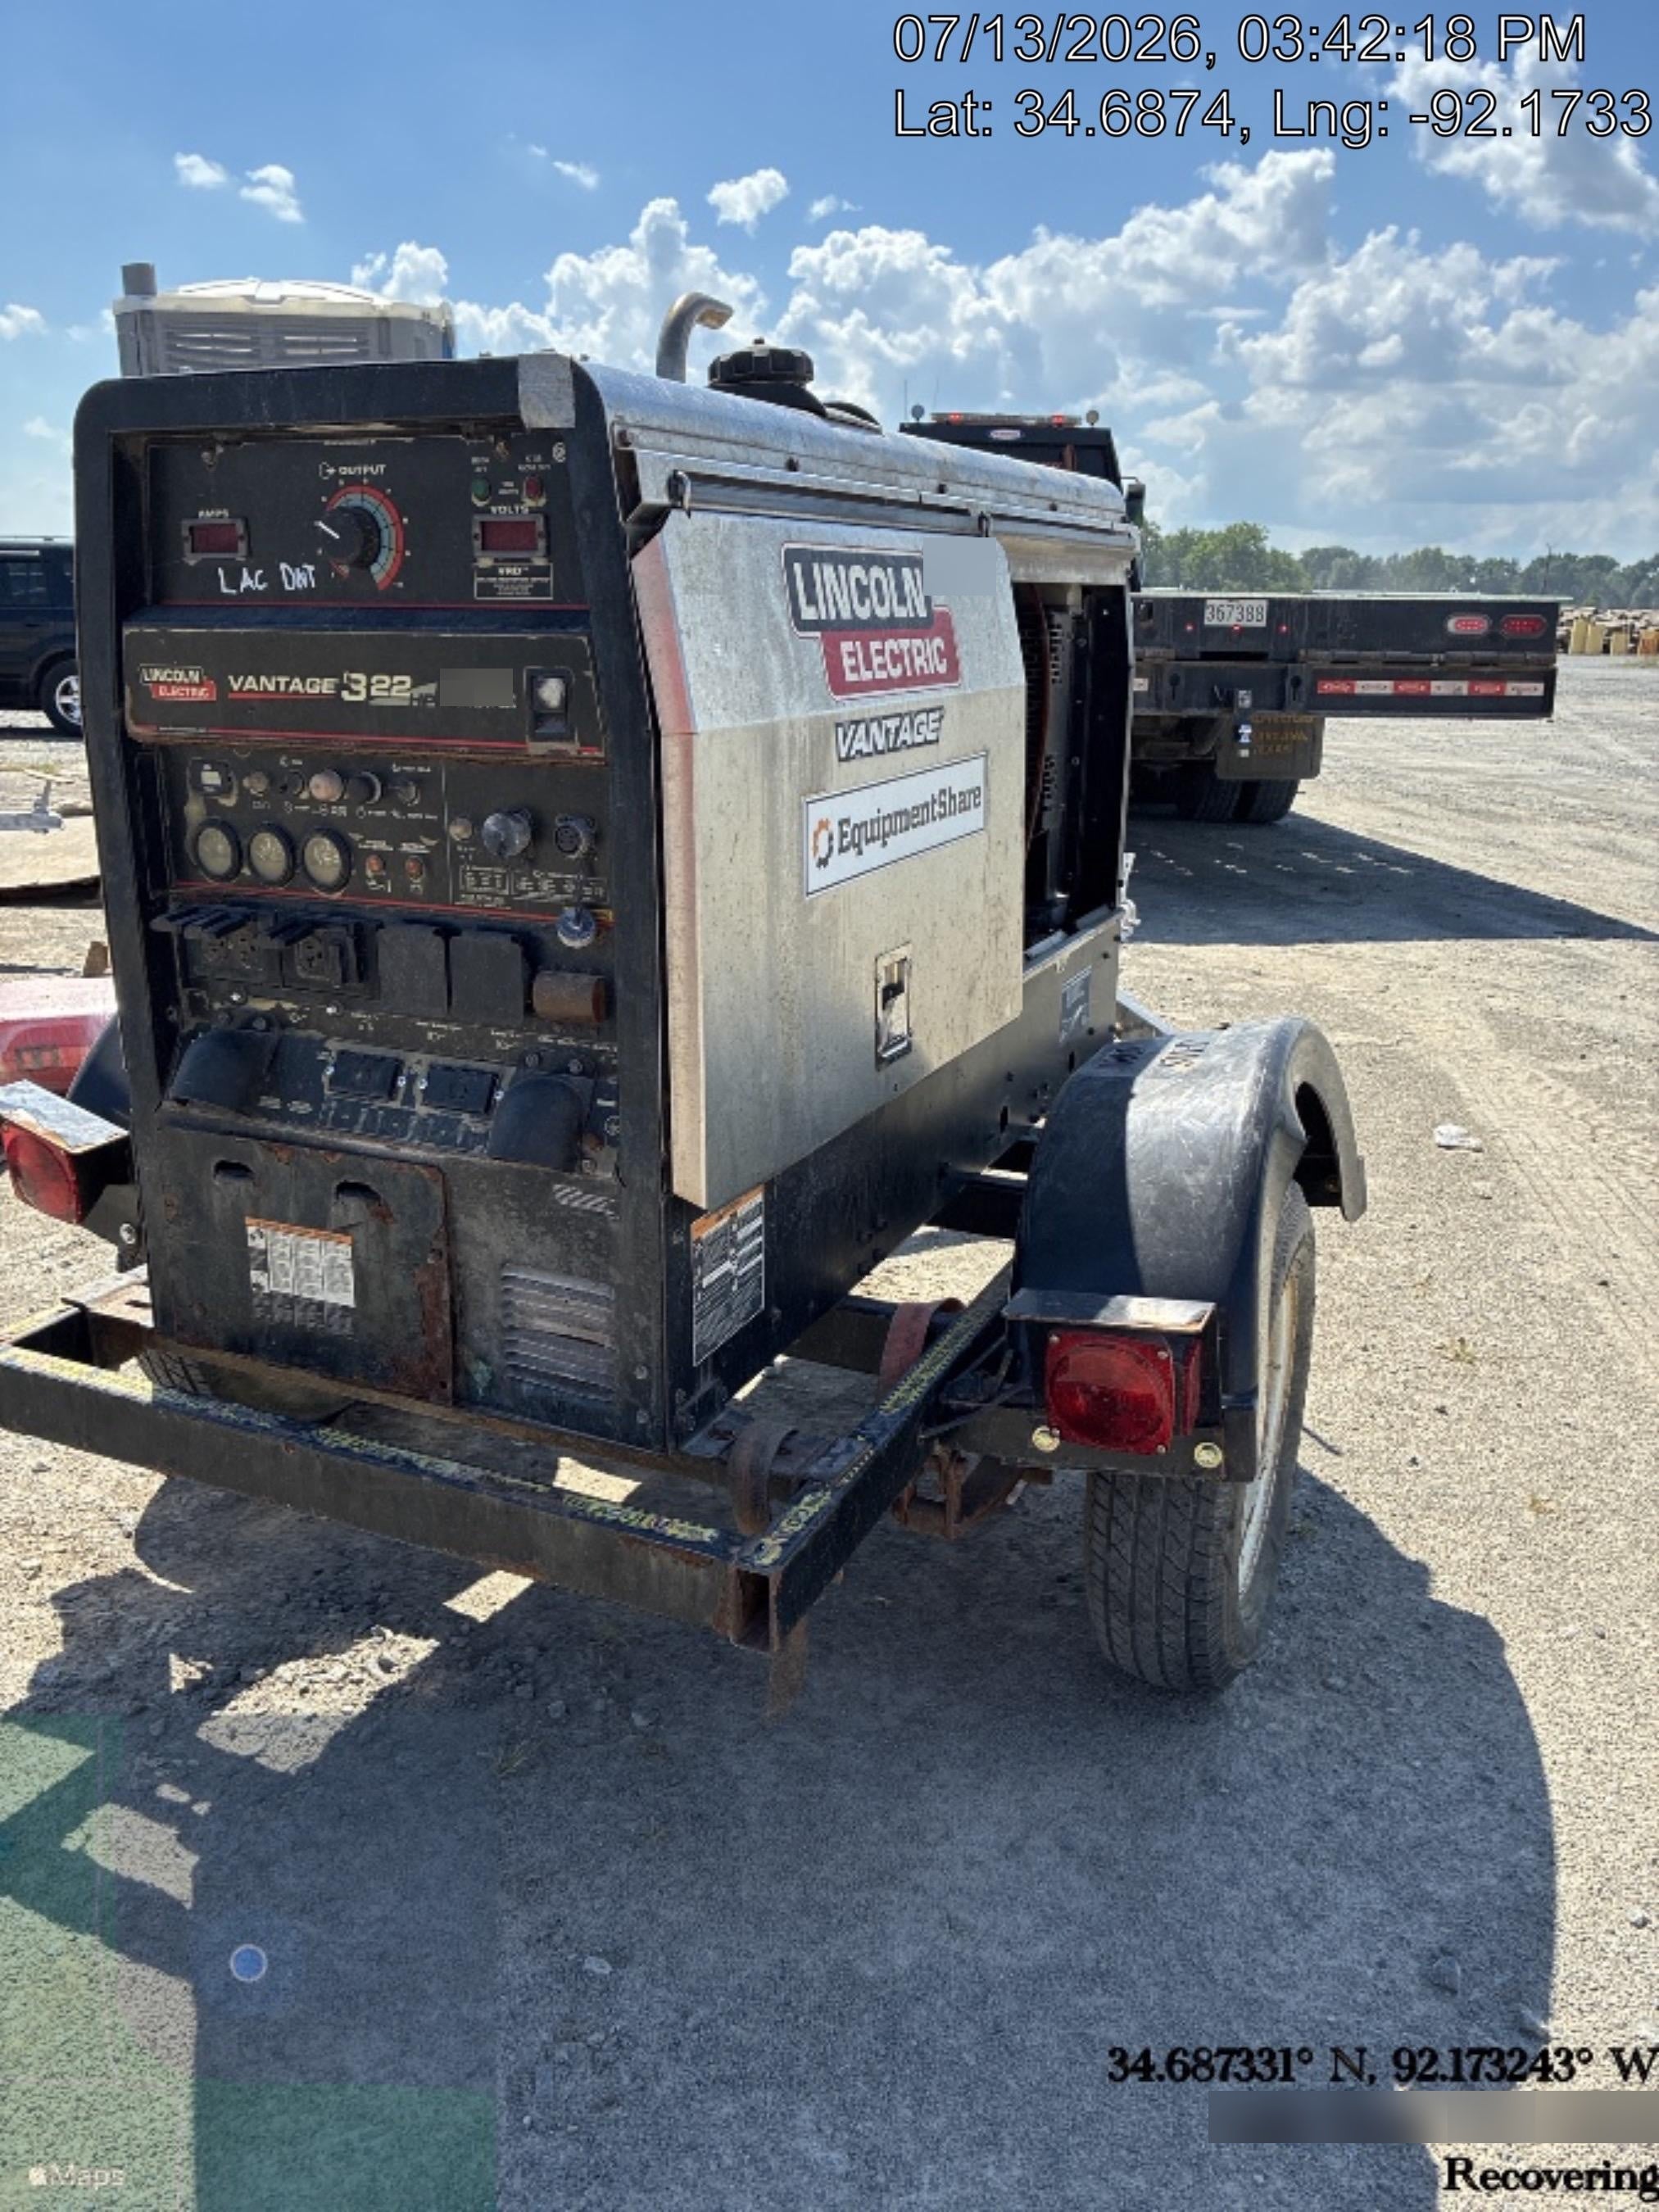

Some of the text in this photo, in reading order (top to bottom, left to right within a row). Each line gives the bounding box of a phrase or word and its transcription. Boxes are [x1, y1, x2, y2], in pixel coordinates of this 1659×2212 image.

[338, 464, 387, 475] OUTPUT
[197, 508, 229, 519] AMPS
[491, 505, 530, 514] VOLTS
[792, 561, 928, 621] LINCOLN
[840, 636, 947, 682] ELECTRIC
[142, 667, 201, 685] LINCOLN
[228, 674, 339, 695] VANTAGE
[341, 672, 412, 702] 322
[158, 684, 210, 699] ELECTRIC
[836, 709, 941, 760] VANTAGE
[837, 785, 982, 857] EquipmentShare
